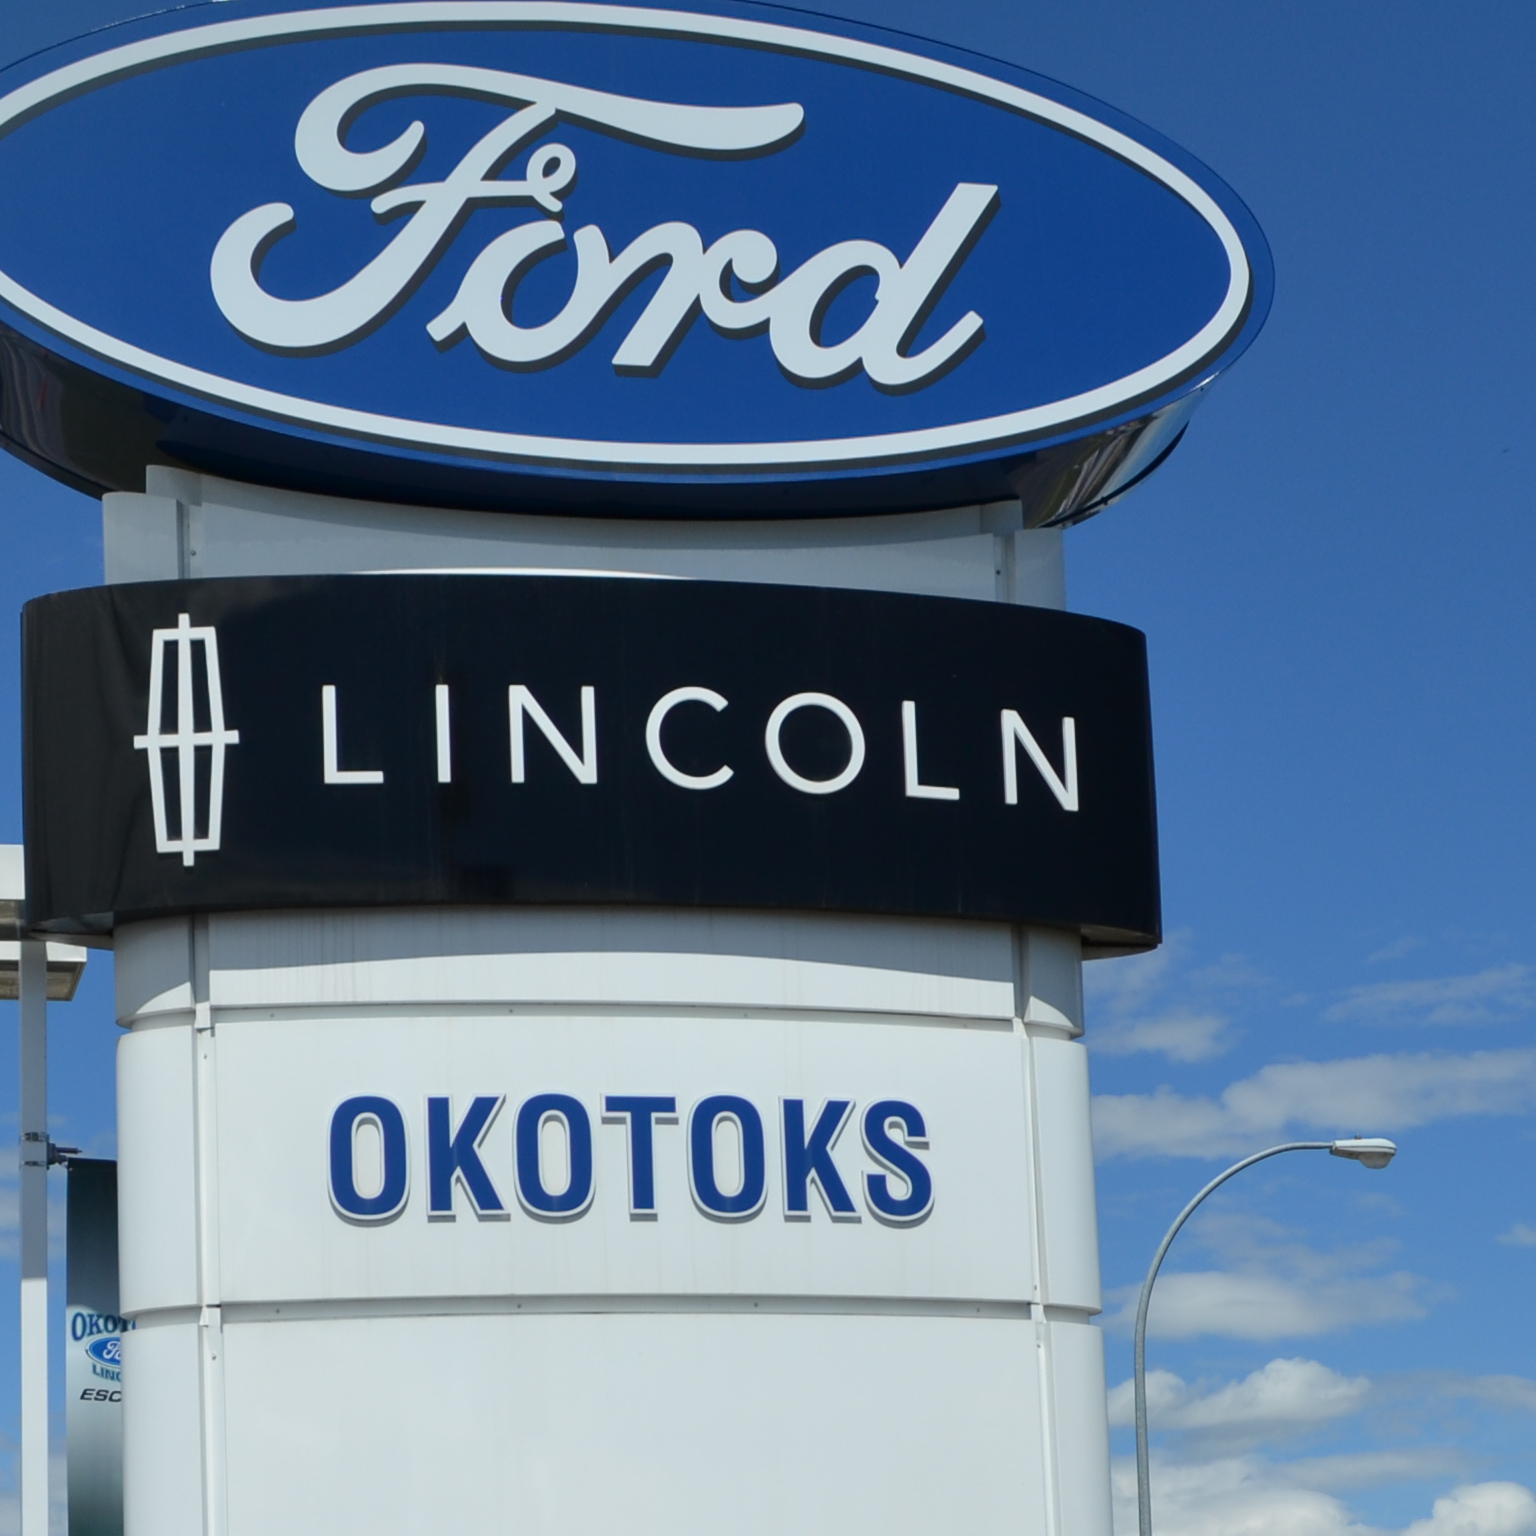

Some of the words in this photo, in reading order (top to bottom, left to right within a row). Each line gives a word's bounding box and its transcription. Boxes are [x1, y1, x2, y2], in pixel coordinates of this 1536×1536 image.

[210, 62, 998, 385] Ford
[322, 684, 1078, 811] LINCOLN
[327, 1092, 934, 1225] OKOTOKS
[71, 1311, 136, 1342] OKOT
[80, 1388, 121, 1403] ESC
[92, 1363, 121, 1382] LINC
